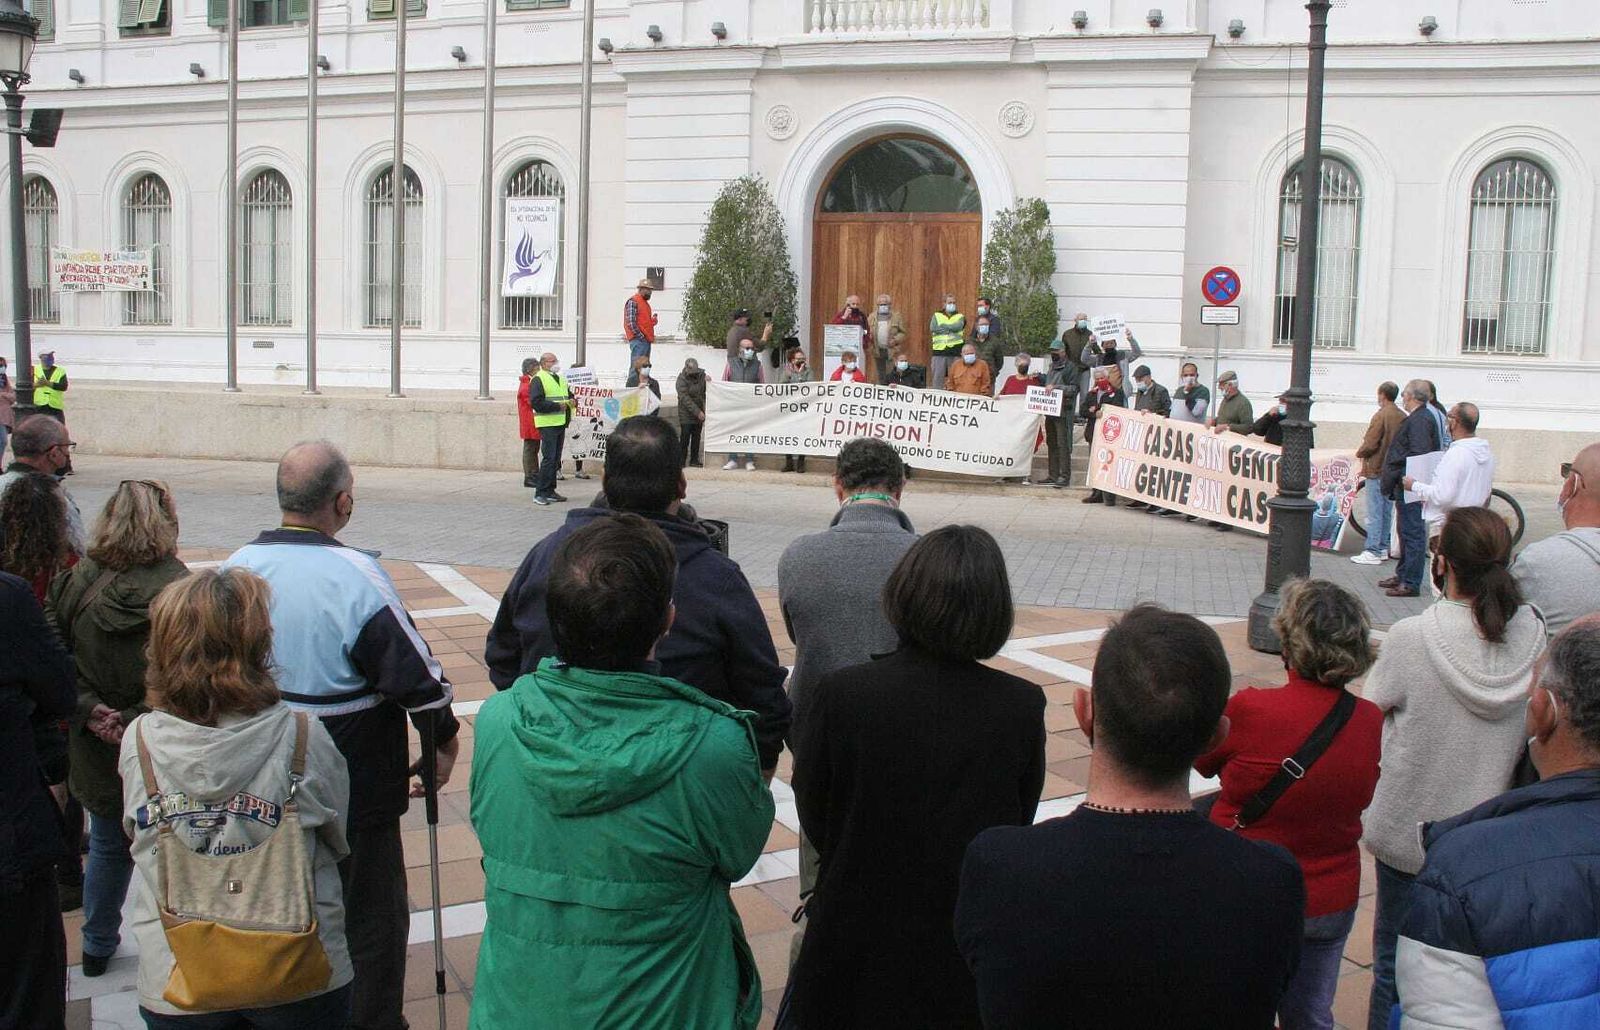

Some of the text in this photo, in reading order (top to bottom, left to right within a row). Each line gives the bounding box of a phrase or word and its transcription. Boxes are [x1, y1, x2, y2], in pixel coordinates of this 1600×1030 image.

[104, 264, 139, 274] PARTICIPAR
[574, 386, 613, 398] DEFENSA
[754, 385, 999, 413] EQUIPO DE GOBIERNO MUNICIPAL
[575, 406, 601, 418] BLICO
[780, 402, 809, 413] POR
[816, 402, 833, 414] TU
[908, 410, 979, 428] NEFASTA
[728, 434, 1014, 467] PORTUENSES CONTR NDONO DE TU CIUDAD
[1123, 419, 1282, 484] NI CASAS SIN GENT
[1331, 466, 1349, 478] STOP
[1115, 457, 1268, 525] NI GENTE SIN CAS
